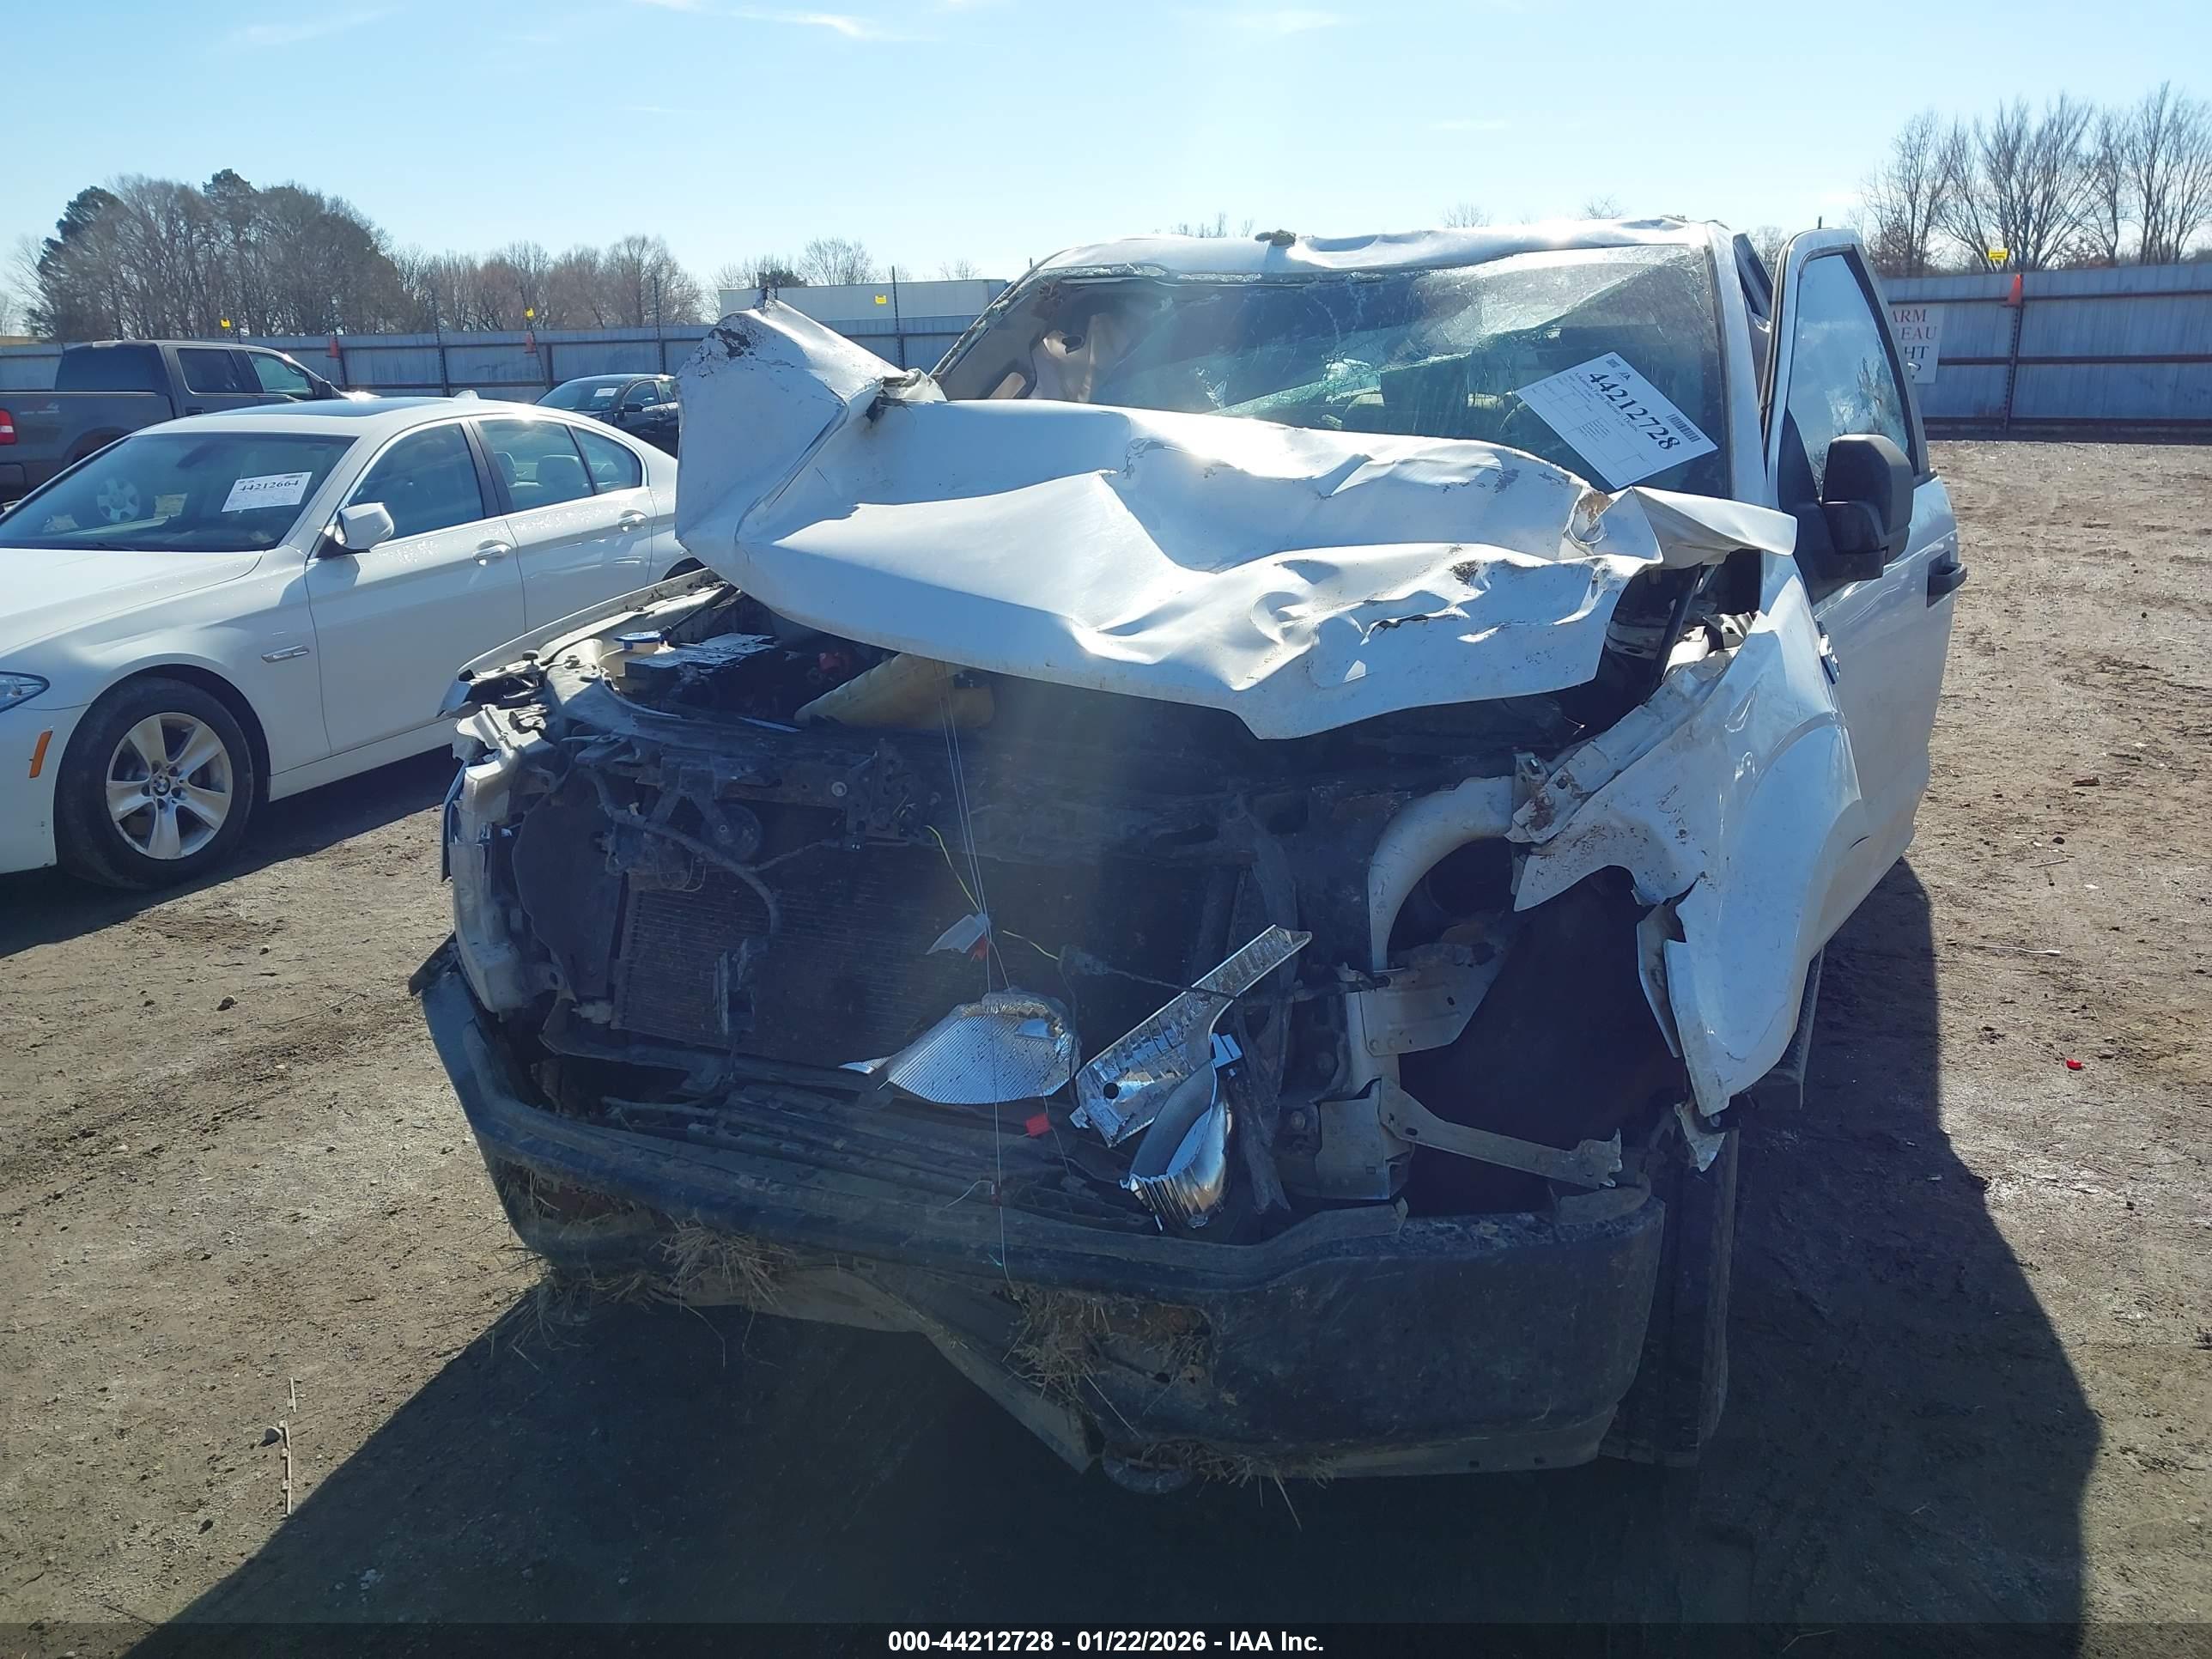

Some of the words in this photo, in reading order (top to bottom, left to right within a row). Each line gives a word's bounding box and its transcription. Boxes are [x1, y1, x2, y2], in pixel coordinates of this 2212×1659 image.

[1896, 325, 1937, 340] EAU
[1589, 371, 1681, 451] 44212728
[240, 479, 300, 492] 44212664
